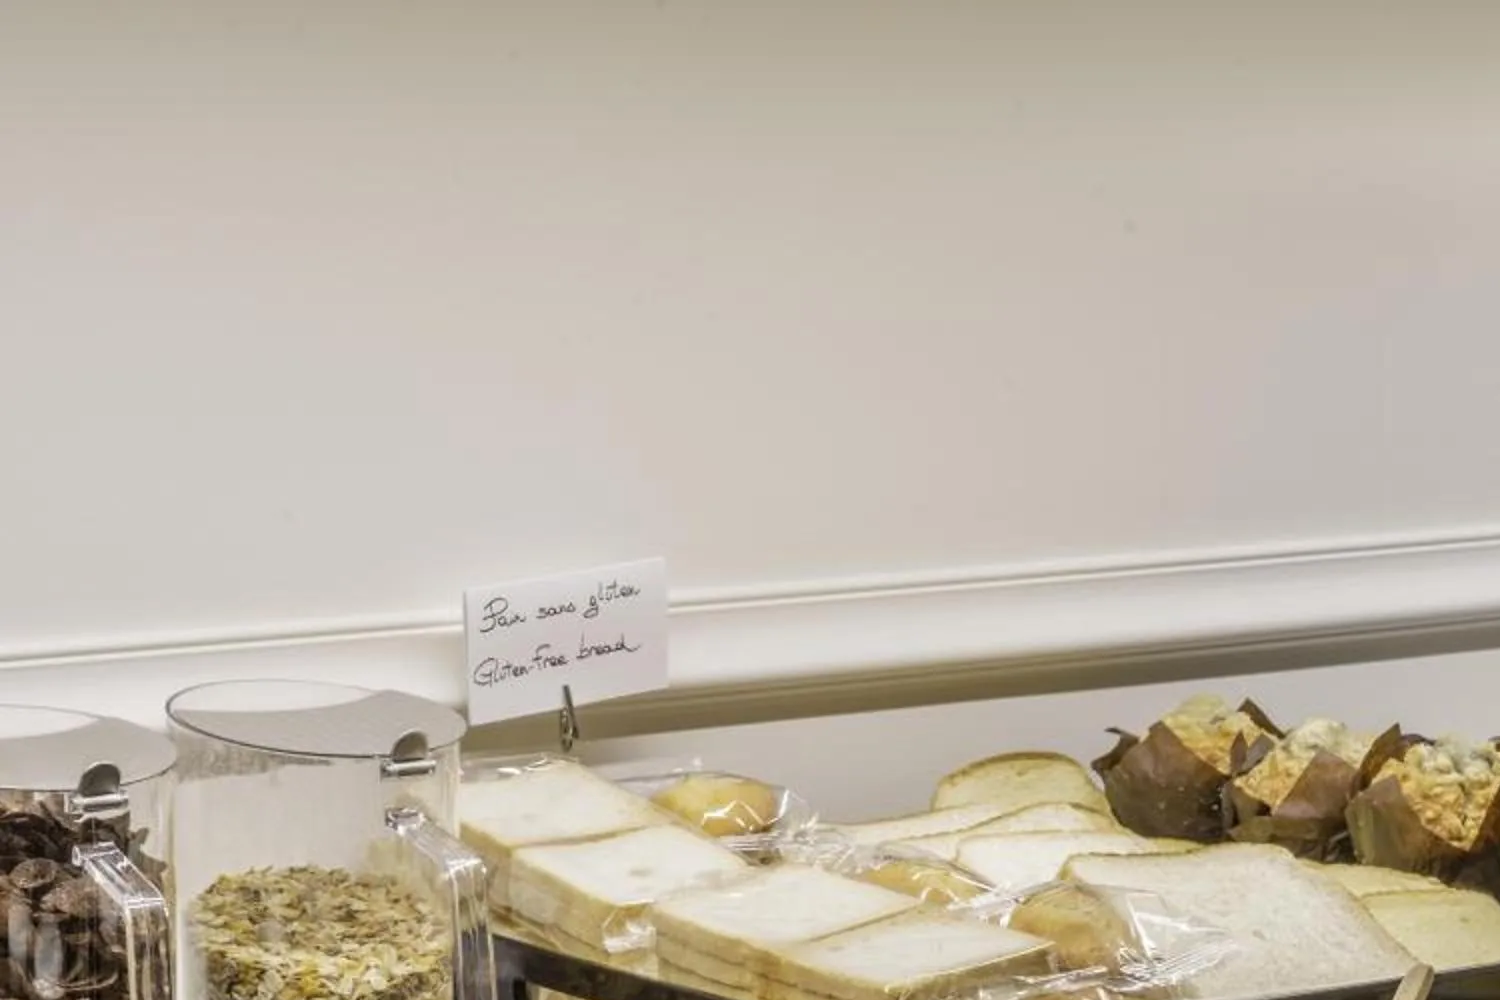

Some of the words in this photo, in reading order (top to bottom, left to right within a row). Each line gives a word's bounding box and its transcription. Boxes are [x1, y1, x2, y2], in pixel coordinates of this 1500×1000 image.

[479, 597, 527, 633] Pain
[535, 601, 577, 620] sans
[582, 578, 642, 619] gluten
[575, 631, 642, 660] bread
